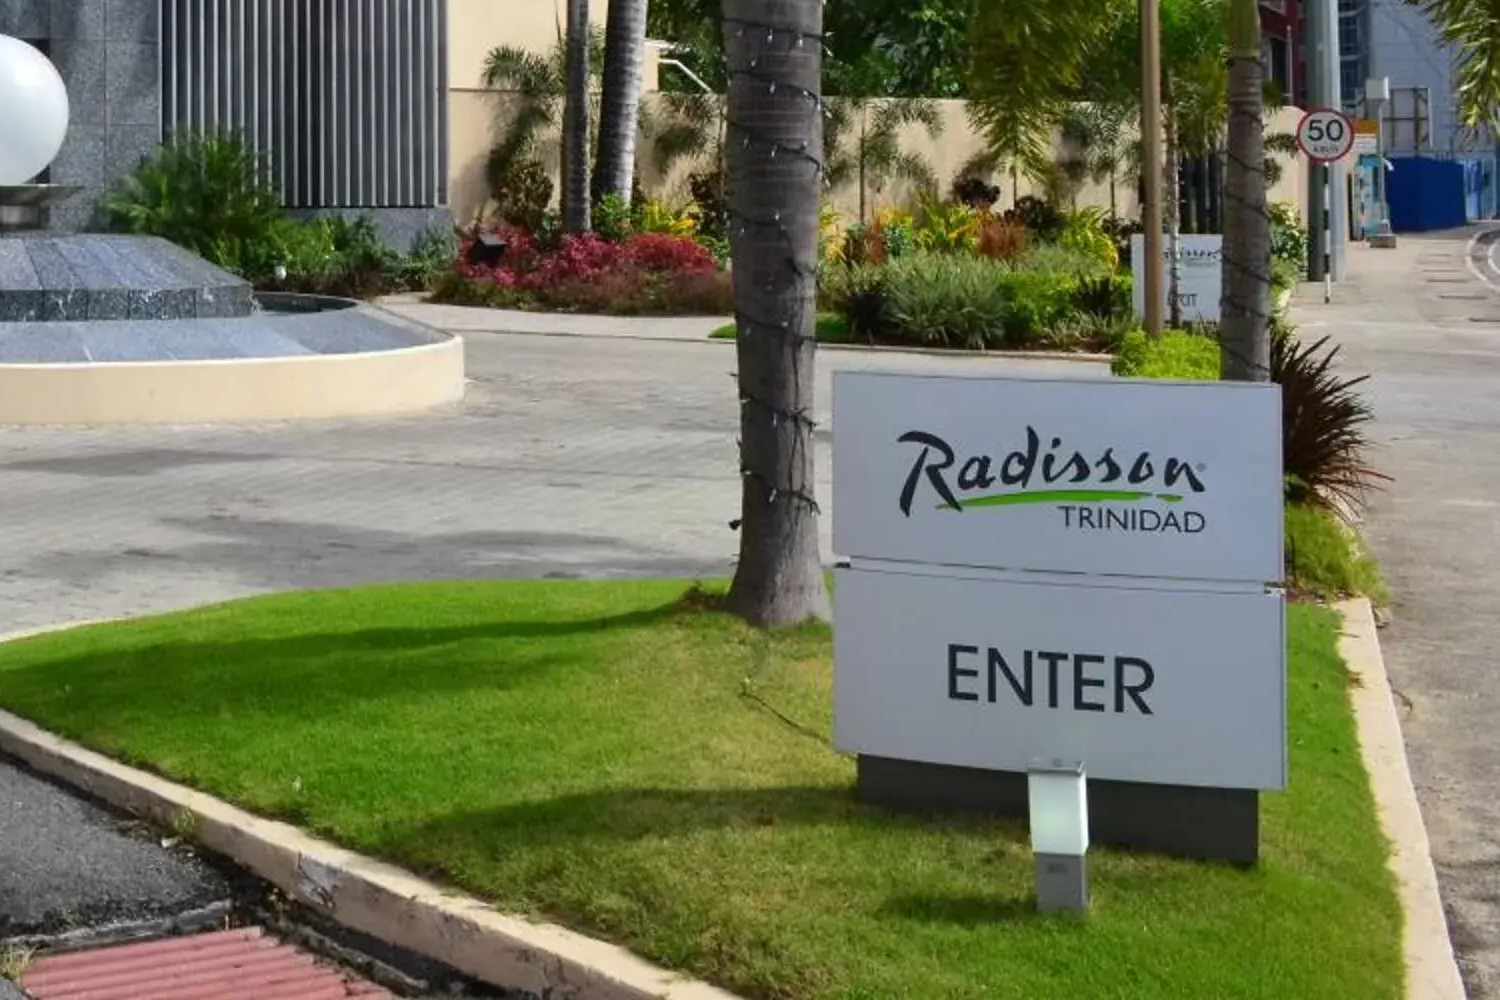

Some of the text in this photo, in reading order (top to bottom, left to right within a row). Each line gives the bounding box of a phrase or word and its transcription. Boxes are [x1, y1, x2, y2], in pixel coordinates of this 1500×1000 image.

[1308, 119, 1344, 141] 50
[897, 425, 1206, 518] Radisson
[1058, 505, 1206, 534] TRINIDAD
[947, 643, 1156, 716] ENTER
